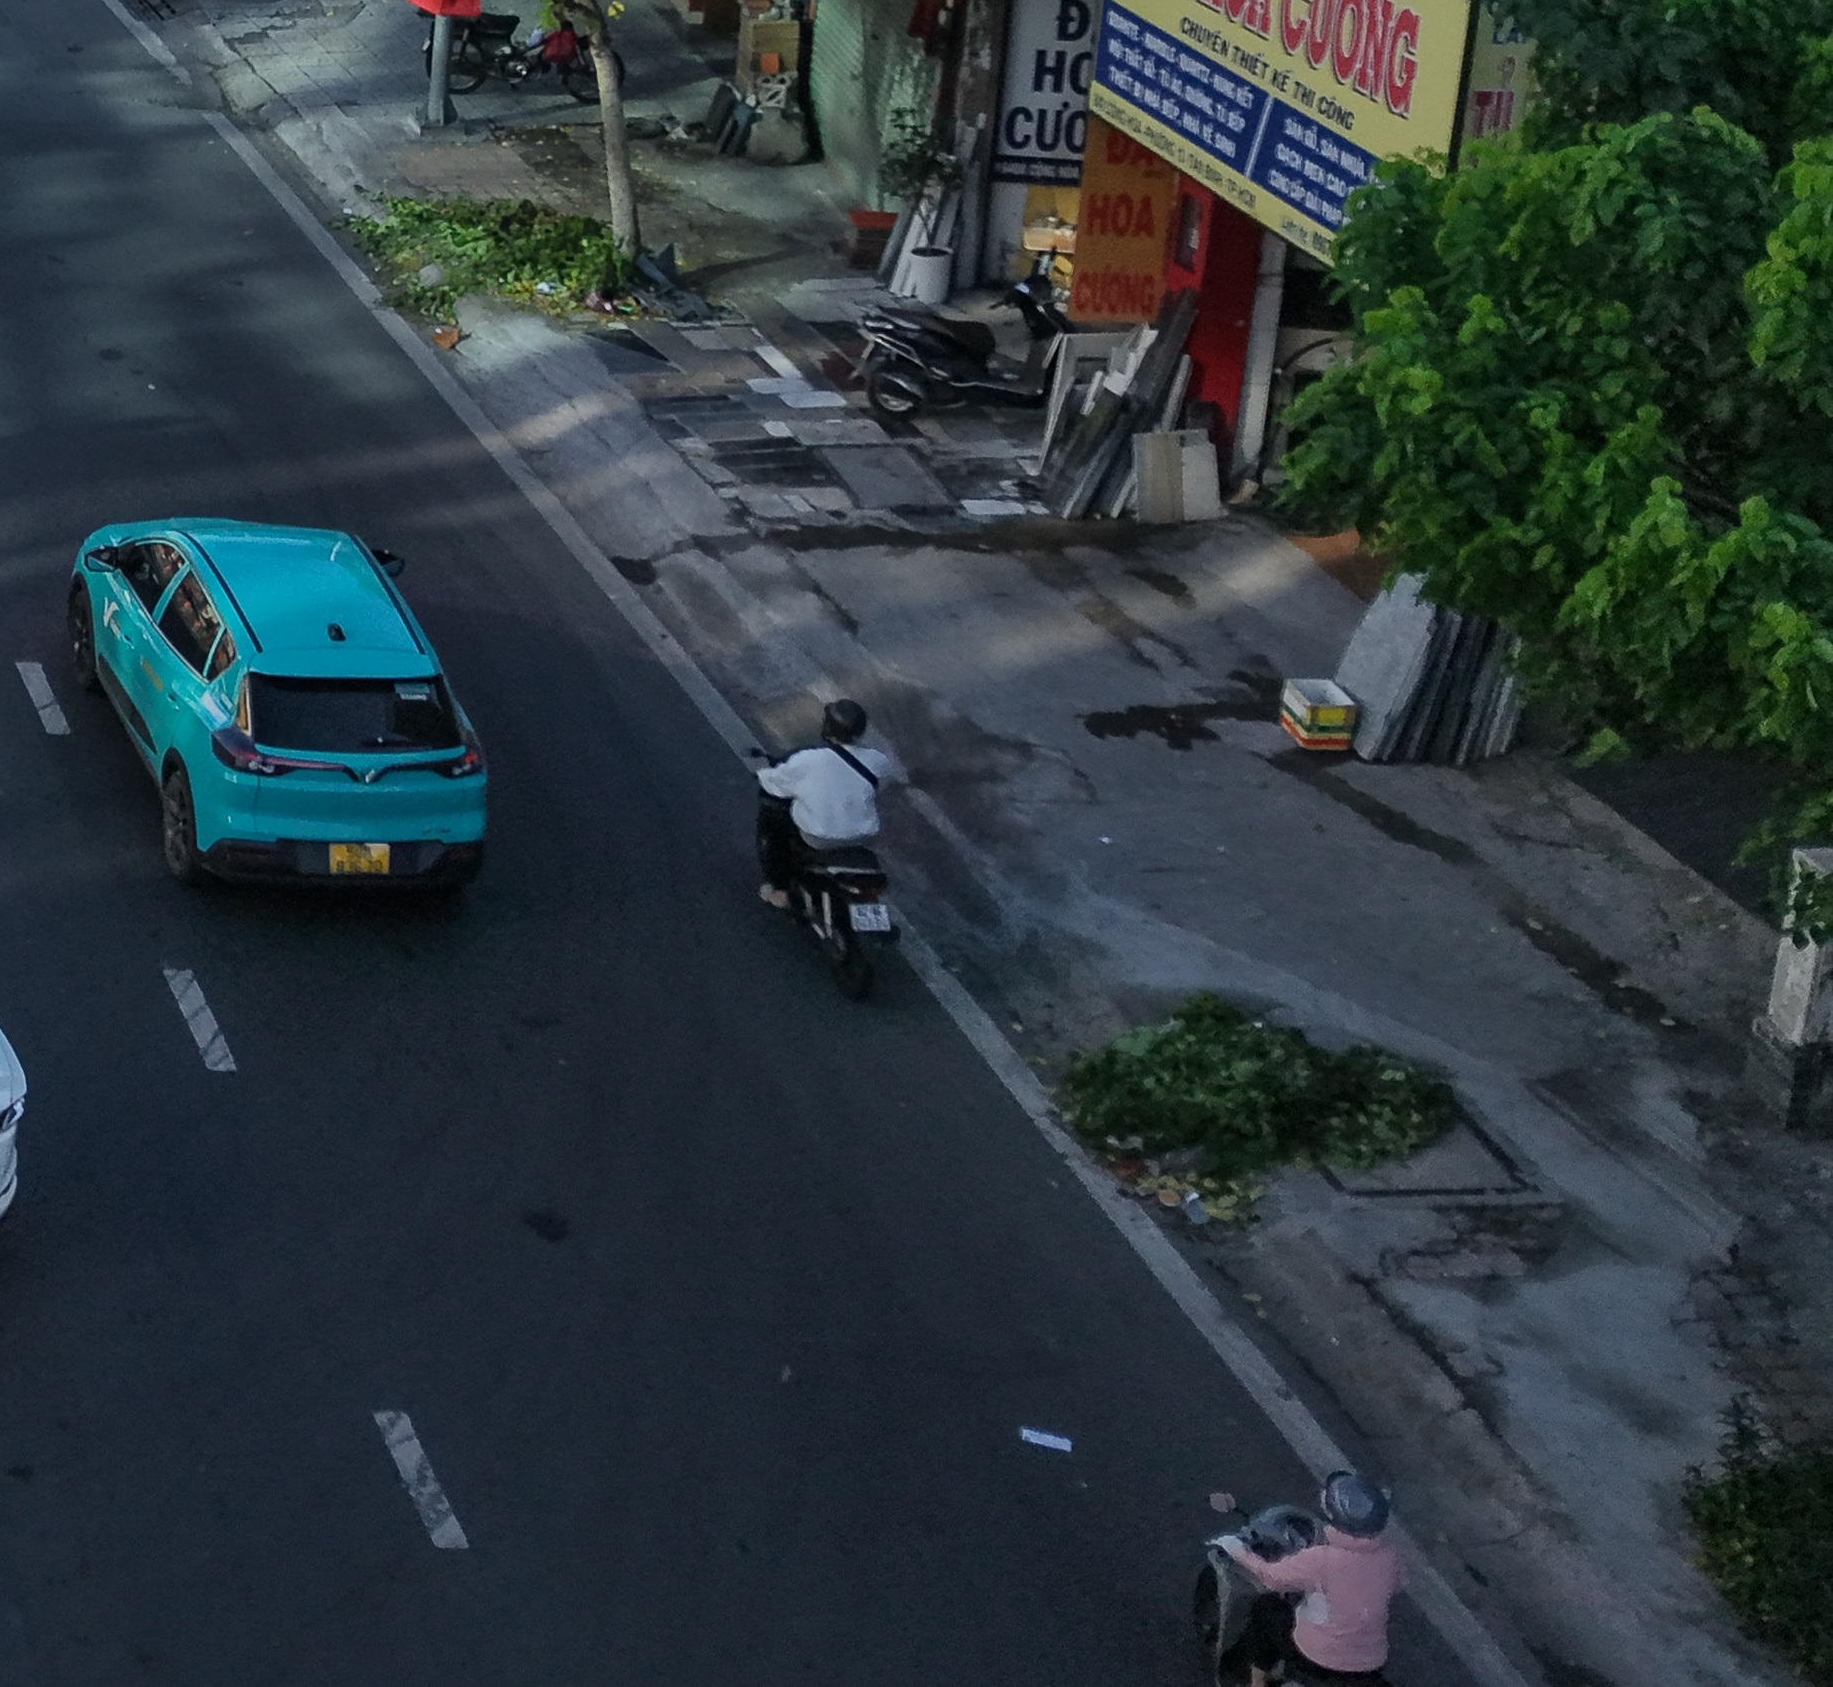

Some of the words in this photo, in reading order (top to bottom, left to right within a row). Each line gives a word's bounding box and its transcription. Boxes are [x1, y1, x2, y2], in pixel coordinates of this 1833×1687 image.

[1181, 16, 1228, 58] CHUYÊN
[1232, 48, 1270, 80] THIẾT
[1271, 69, 1293, 94] KẾ
[1293, 80, 1316, 110] THI
[1316, 95, 1356, 131] CÔNG
[1086, 193, 1155, 238] HOA
